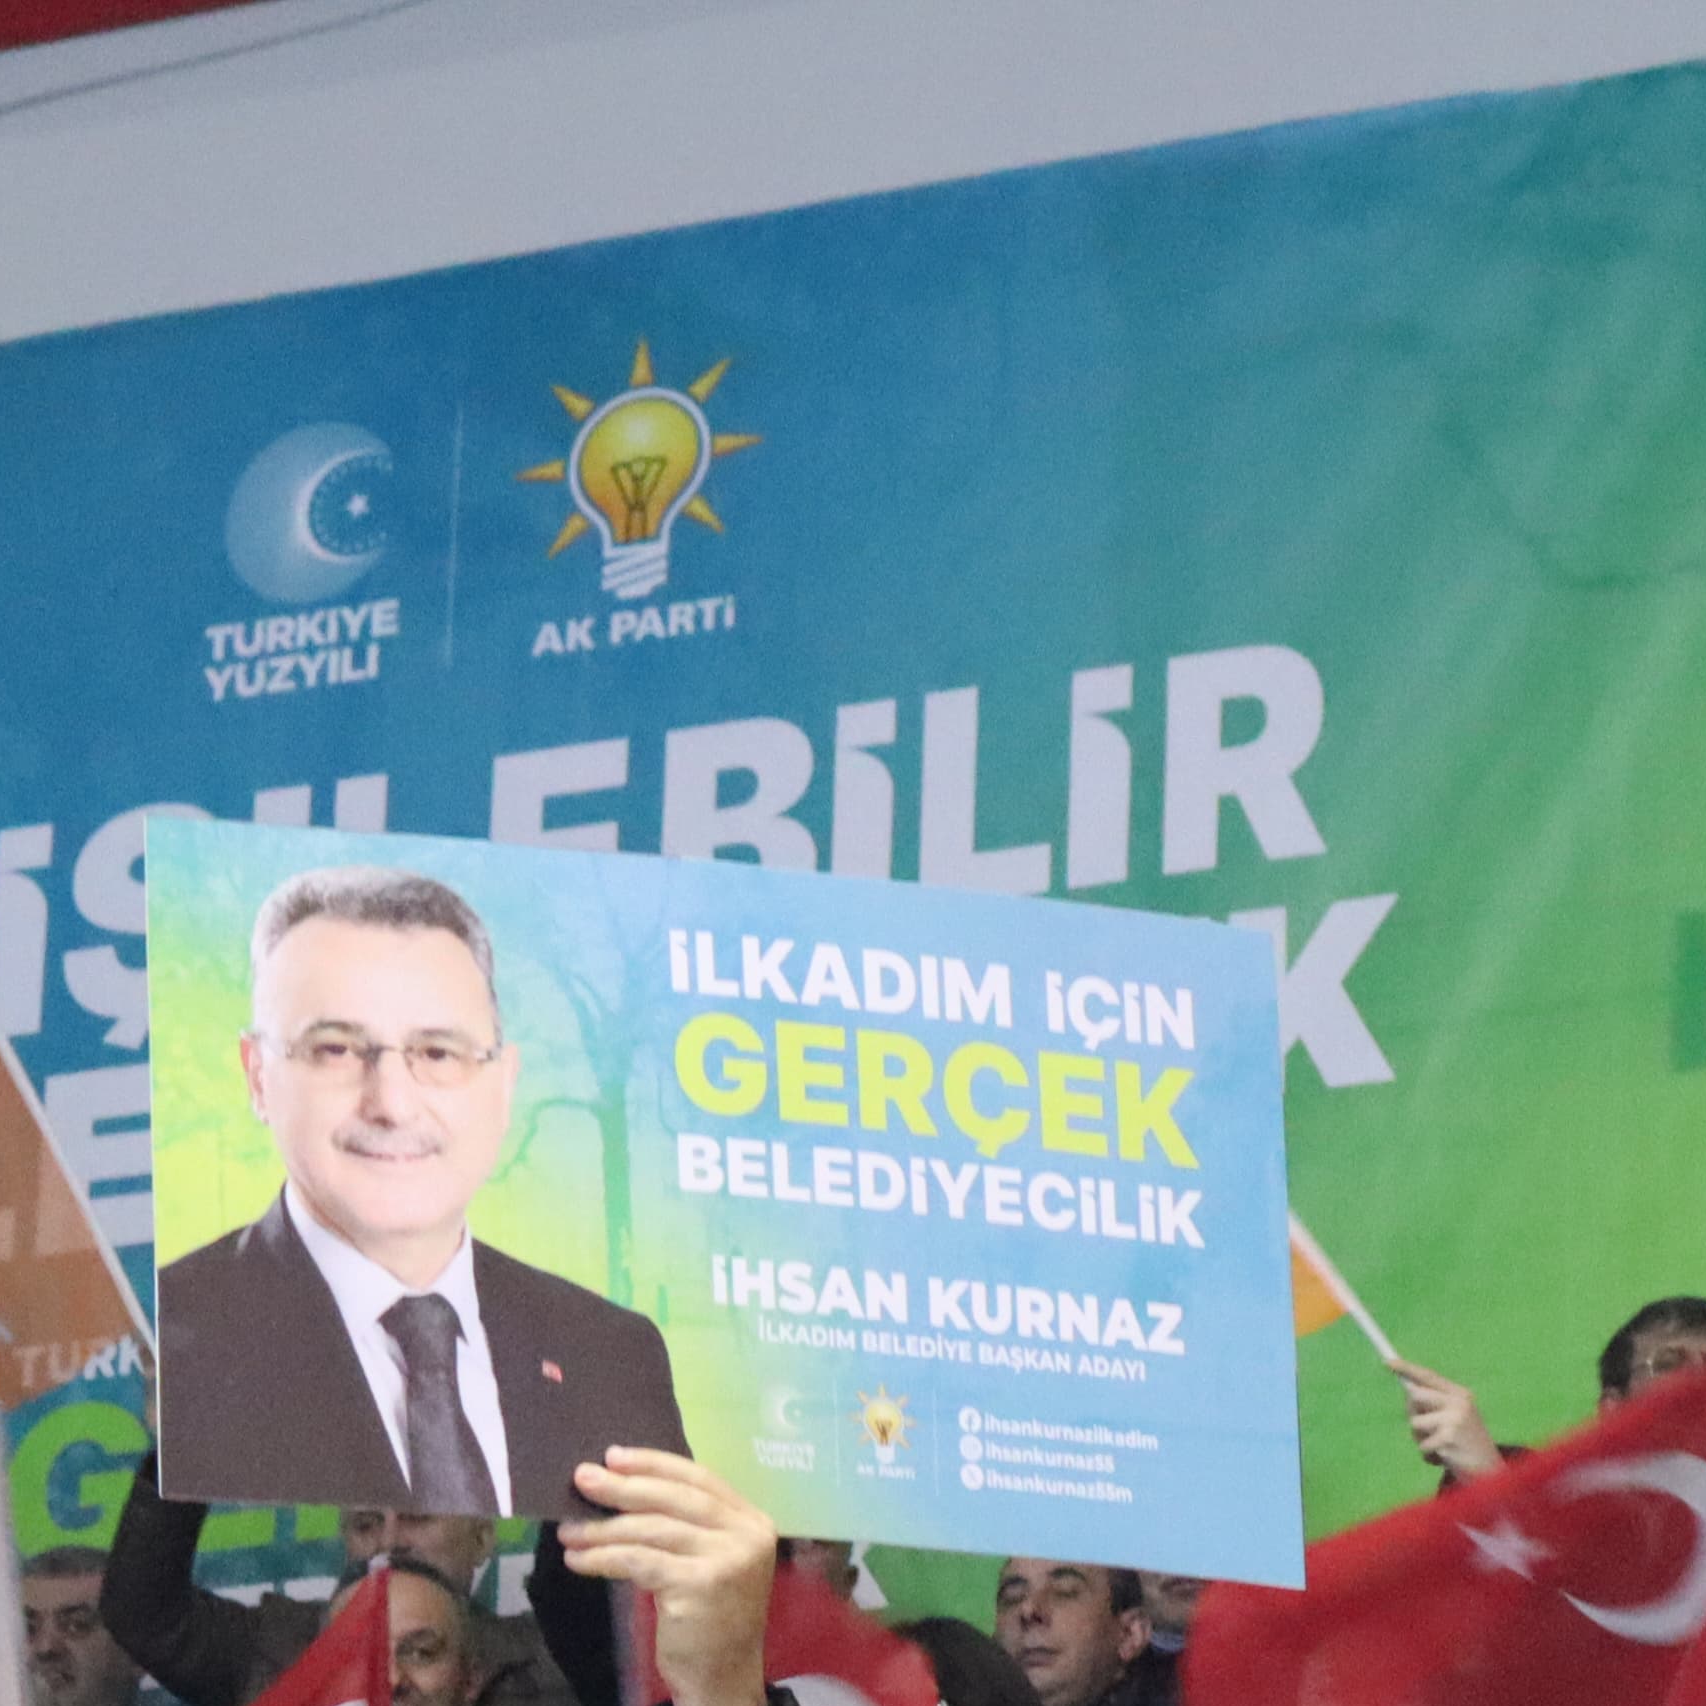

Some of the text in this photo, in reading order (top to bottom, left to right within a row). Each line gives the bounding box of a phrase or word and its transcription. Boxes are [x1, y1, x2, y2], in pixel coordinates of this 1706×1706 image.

[531, 617, 596, 657] AK
[673, 1012, 1201, 1169] GERÇEK
[927, 1276, 1186, 1356] KURNAZ
[979, 1342, 1071, 1375] BAŞKAN
[1077, 1354, 1147, 1382] ADAYI
